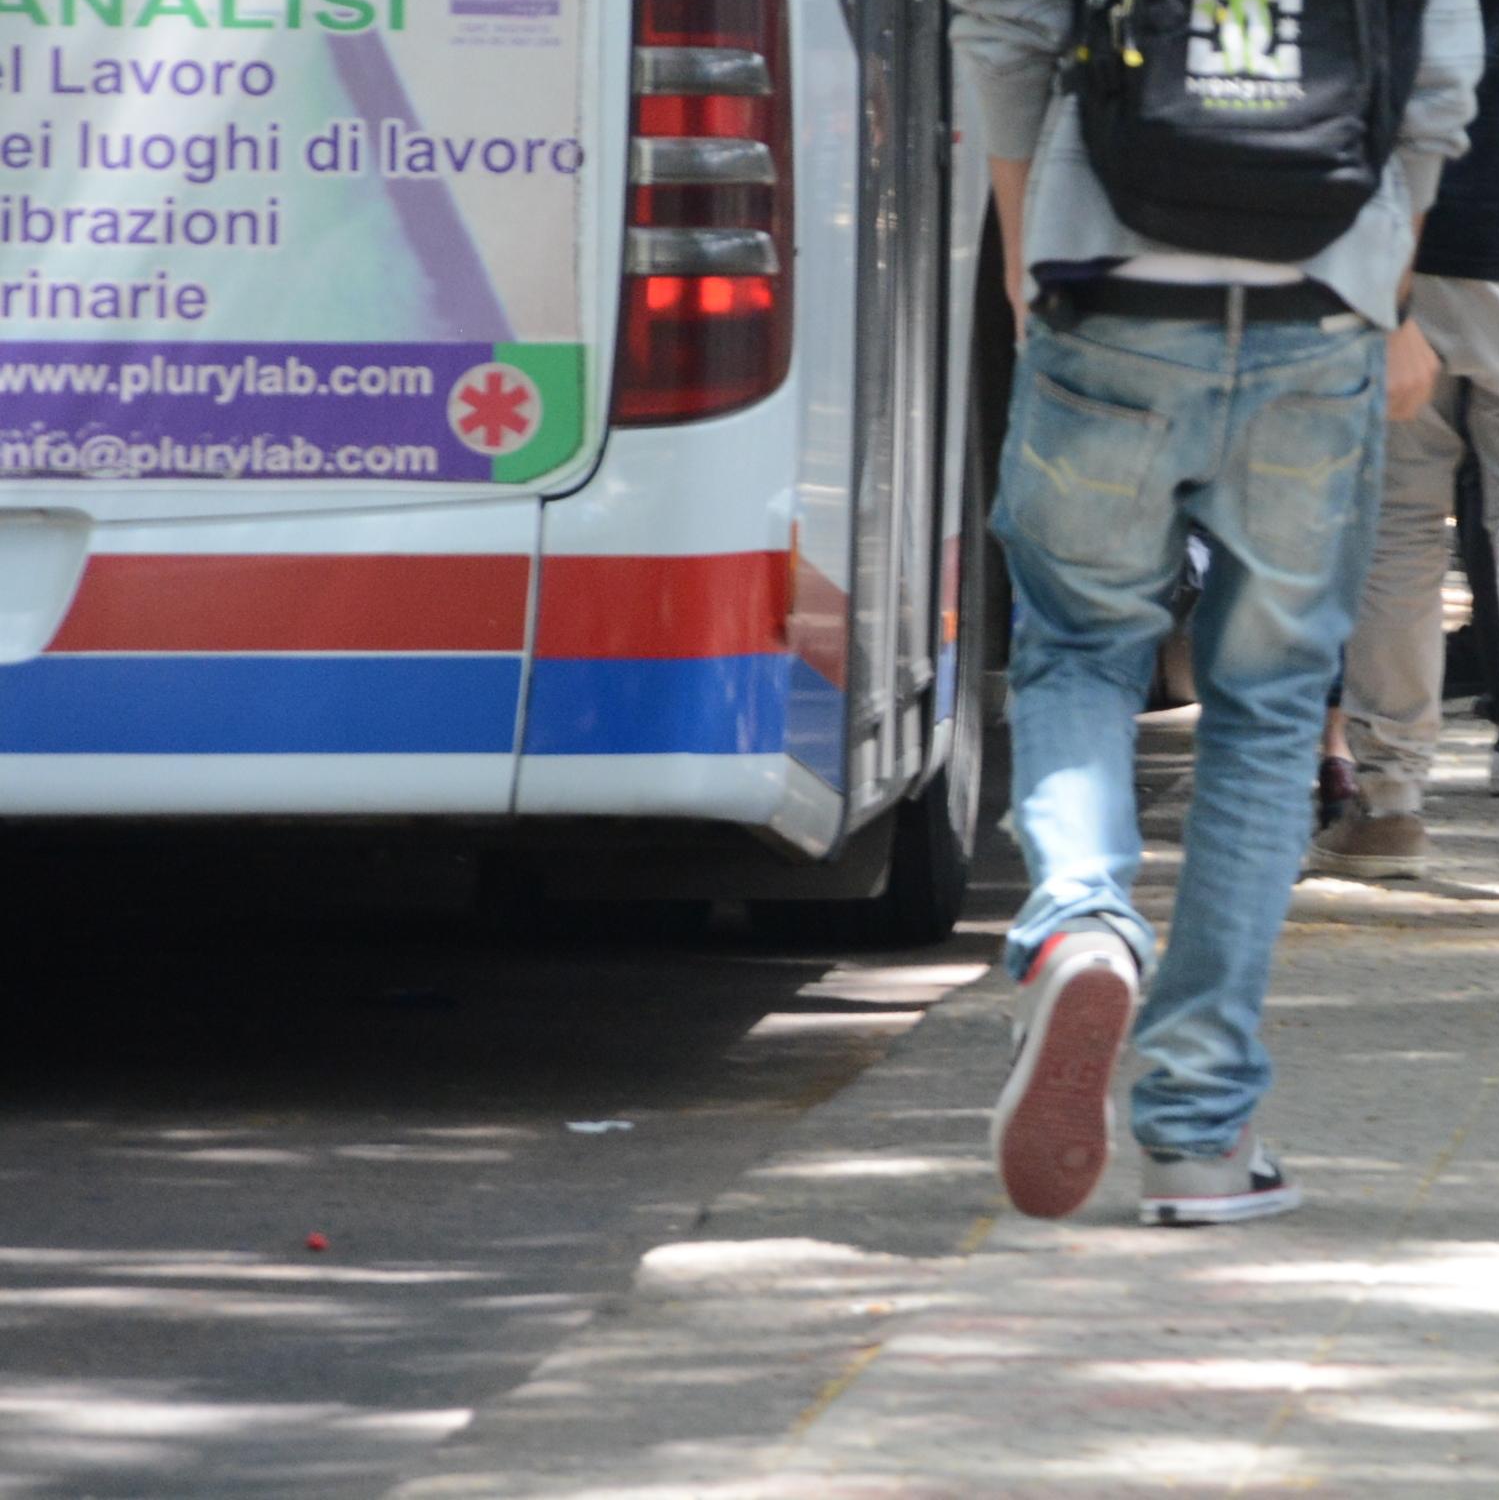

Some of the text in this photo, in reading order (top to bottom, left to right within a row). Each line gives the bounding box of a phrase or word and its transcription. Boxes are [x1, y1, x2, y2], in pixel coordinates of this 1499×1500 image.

[51, 46, 275, 97] Lavoro
[79, 121, 280, 184] luoghi
[307, 123, 358, 171] di
[389, 124, 585, 174] lavoro
[0, 195, 279, 245] ibrazioni
[0, 269, 207, 320] rinarie
[0, 355, 434, 405] www.plurylab.com
